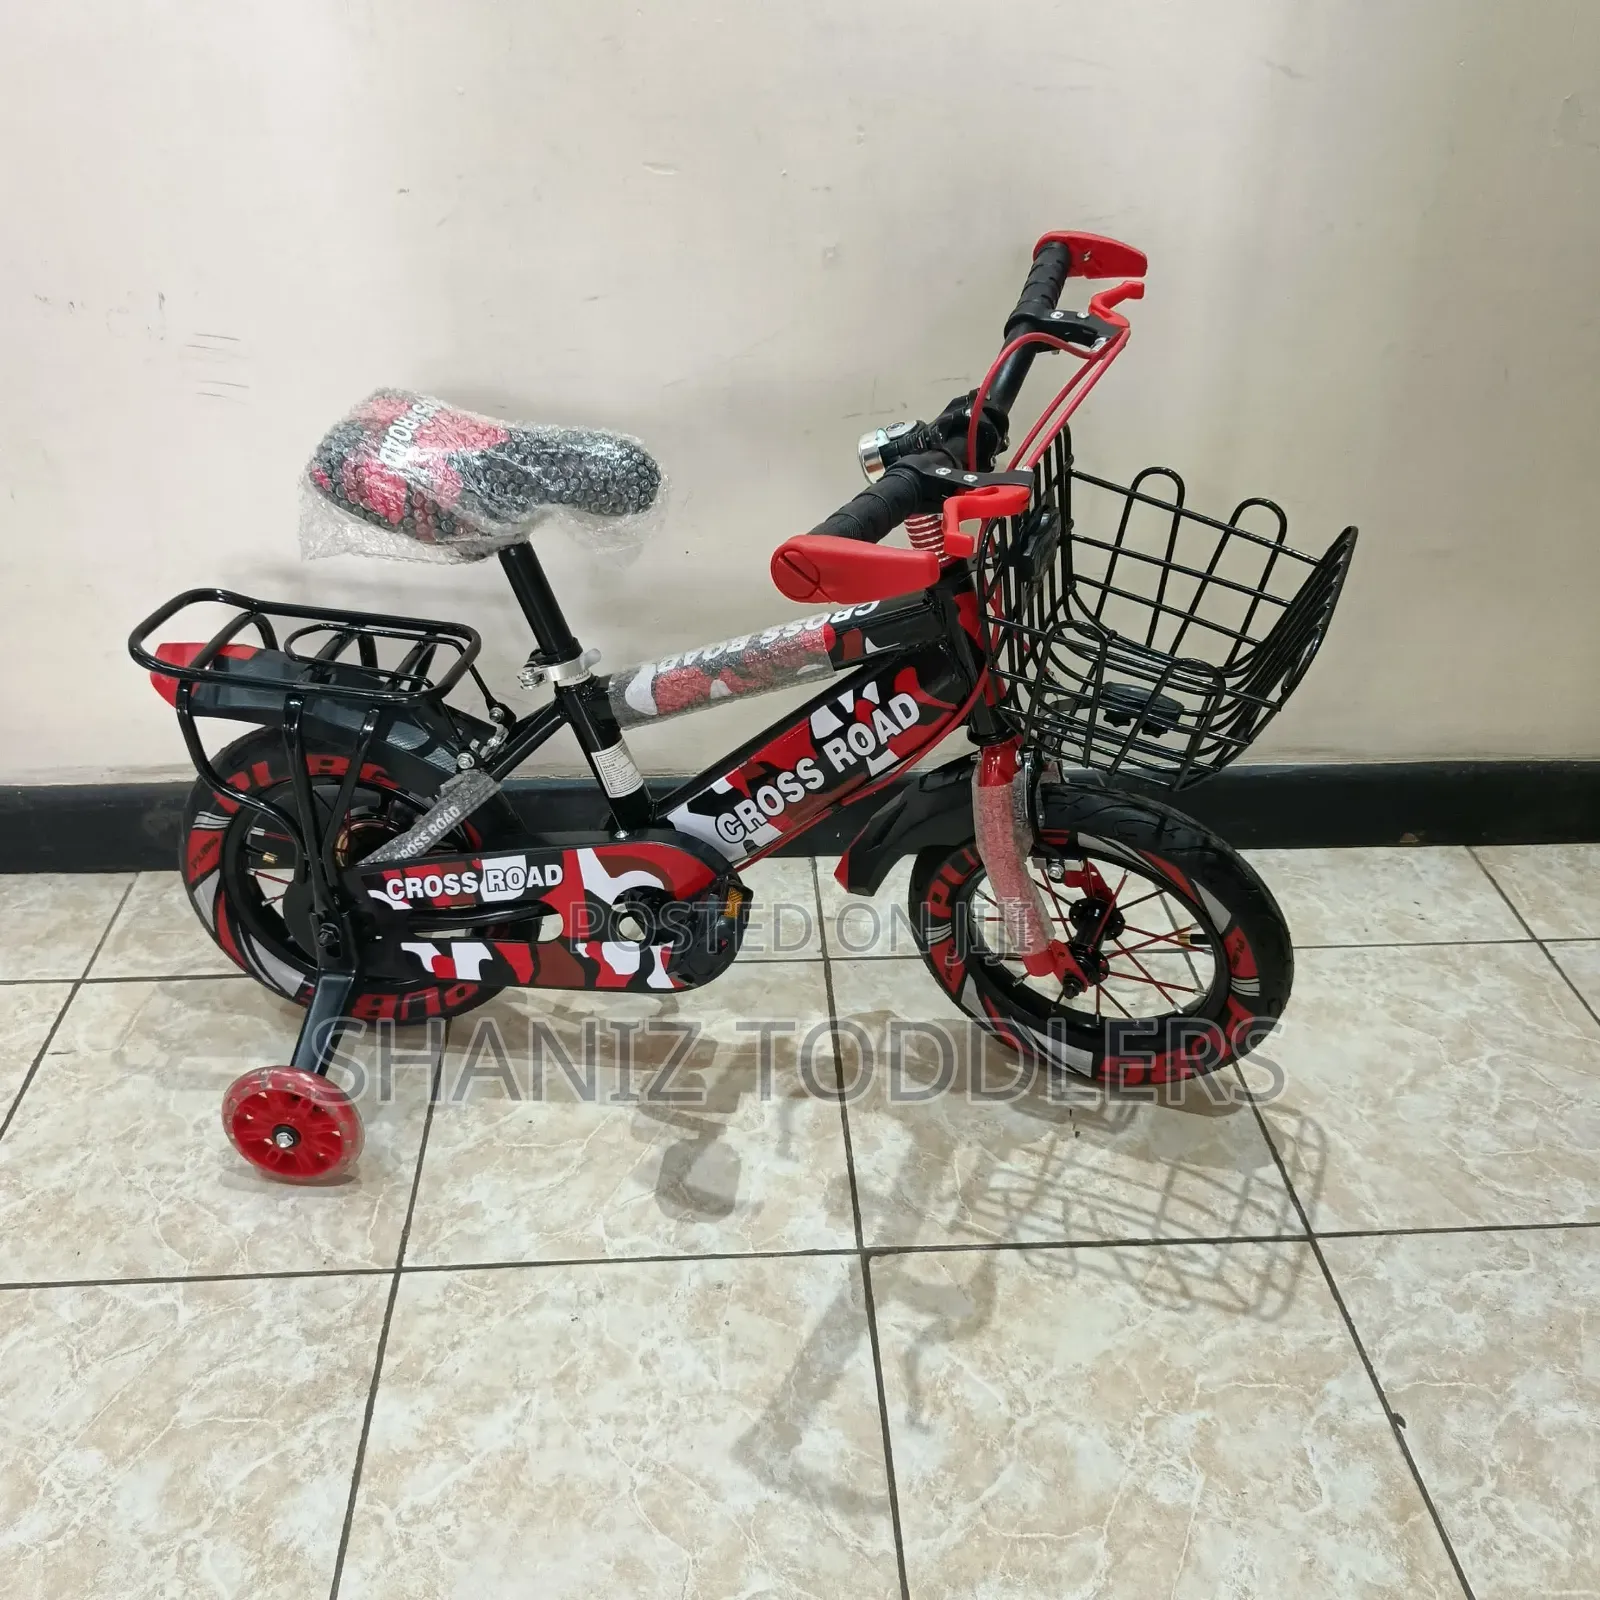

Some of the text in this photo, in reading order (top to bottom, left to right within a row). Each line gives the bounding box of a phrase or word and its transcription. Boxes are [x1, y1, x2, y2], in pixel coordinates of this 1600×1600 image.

[714, 757, 825, 844] CROSS
[822, 692, 920, 773] ROAD
[427, 805, 461, 836] ROAD
[386, 864, 564, 901] CROSS ROAD
